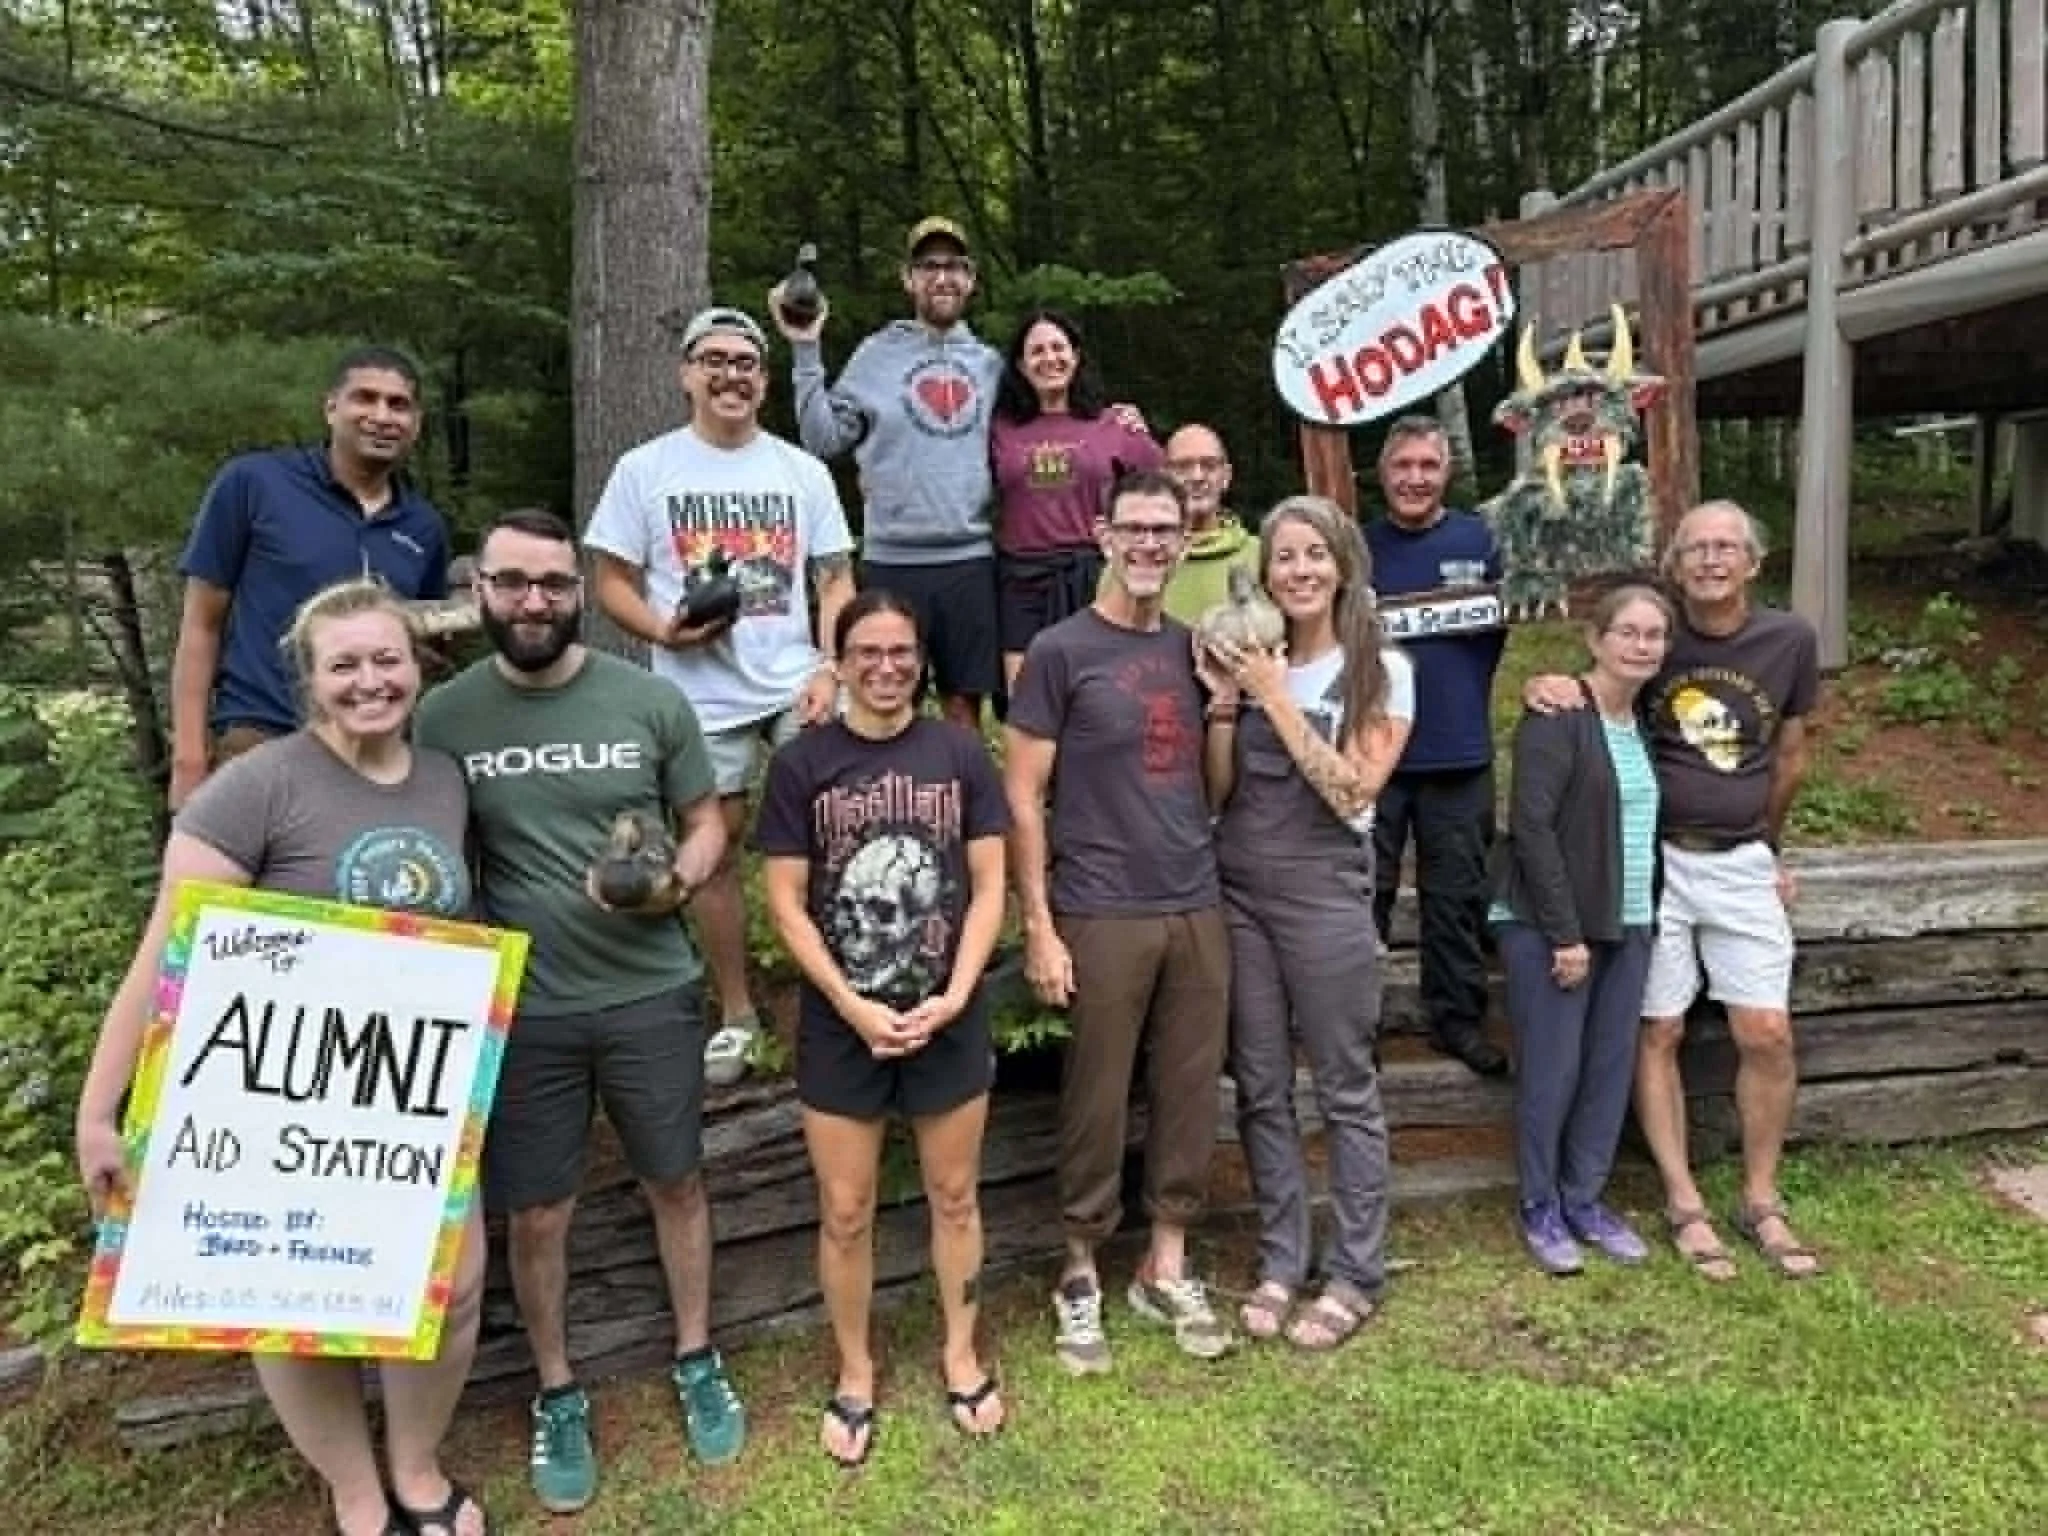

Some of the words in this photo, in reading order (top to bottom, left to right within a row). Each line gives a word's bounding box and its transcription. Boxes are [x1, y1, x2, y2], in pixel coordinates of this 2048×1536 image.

[1307, 263, 1510, 420] HODAG!
[463, 742, 642, 780] ROGUE
[180, 992, 468, 1118] ALUMNI
[167, 1113, 242, 1173] AID
[272, 1124, 446, 1188] STATION
